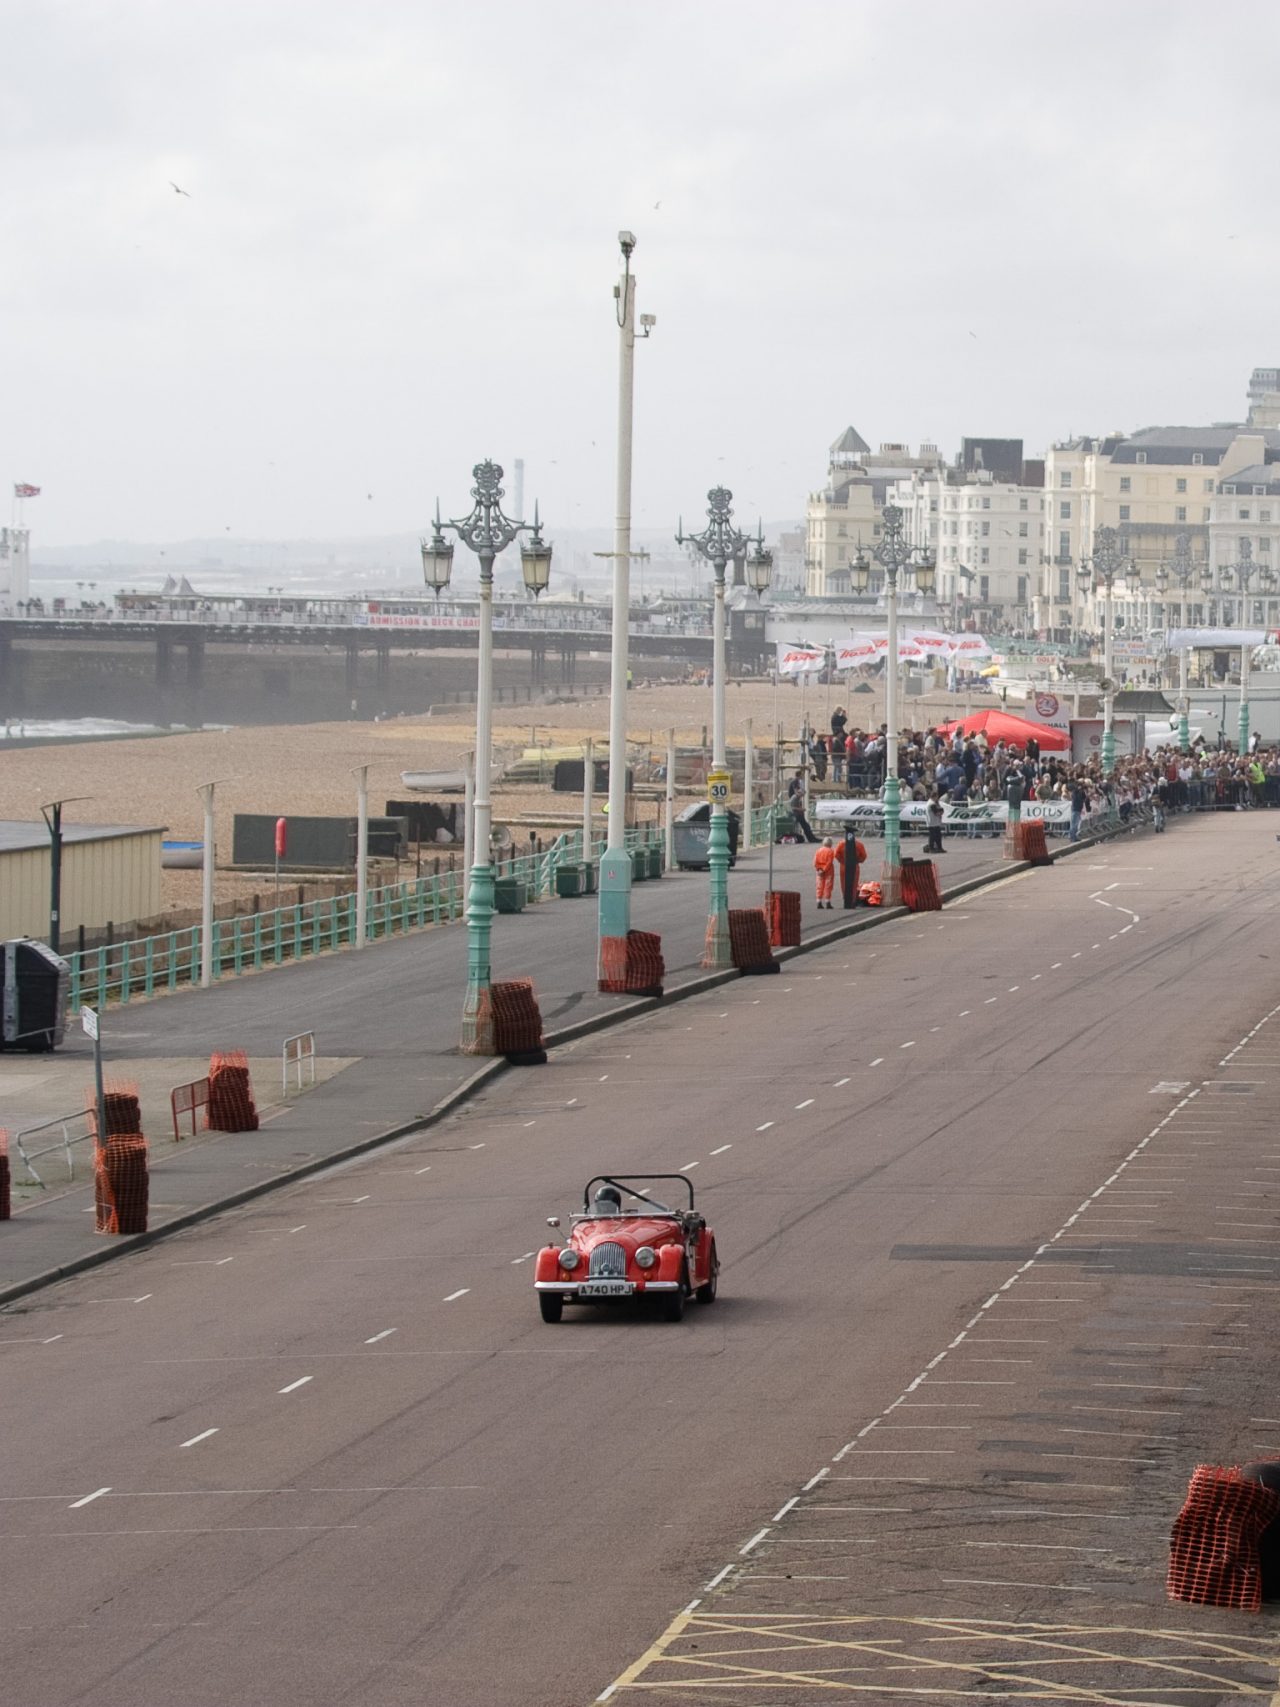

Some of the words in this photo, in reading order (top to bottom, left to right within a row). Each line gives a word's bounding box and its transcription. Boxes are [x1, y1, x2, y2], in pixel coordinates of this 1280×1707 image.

[711, 785, 727, 796] 30
[1027, 806, 1063, 818] LOTUS
[580, 1285, 608, 1295] A740
[609, 1284, 633, 1295] HPJ
